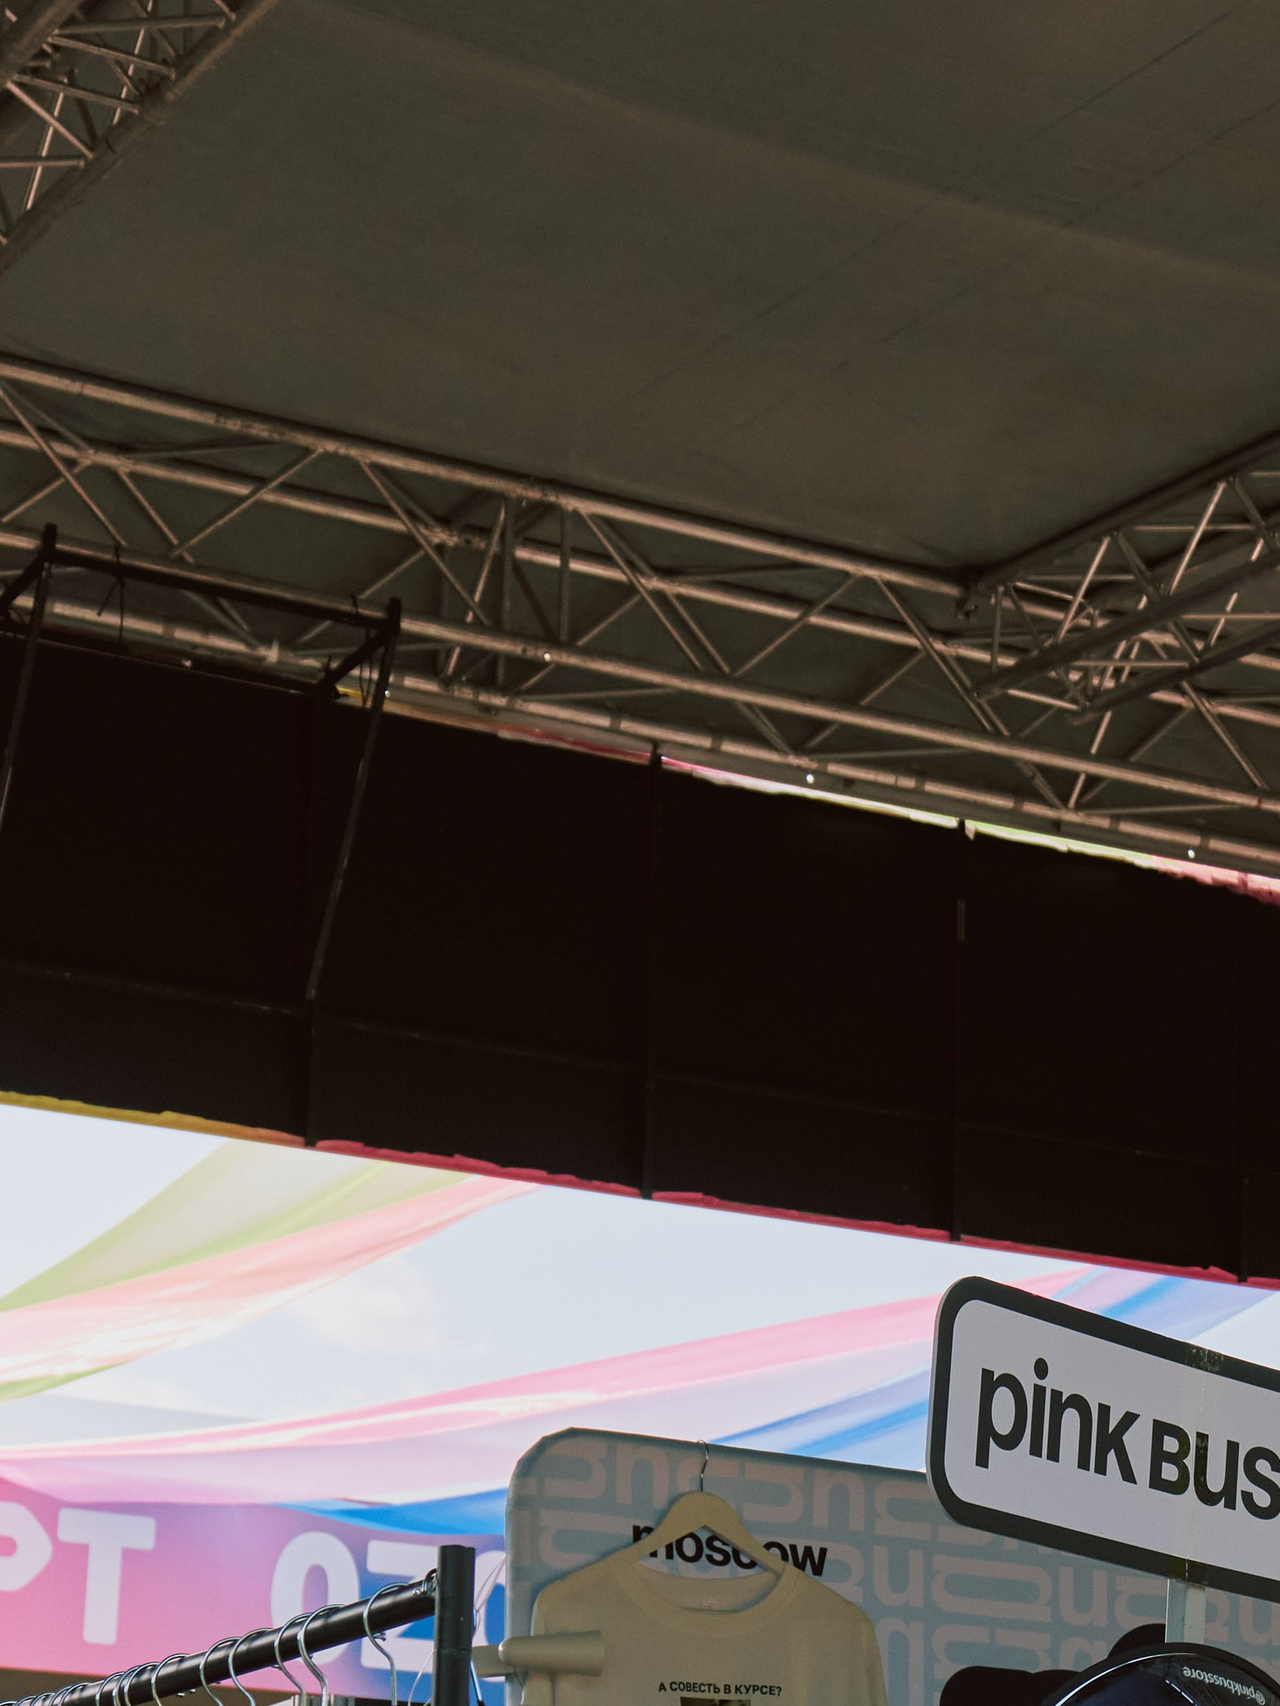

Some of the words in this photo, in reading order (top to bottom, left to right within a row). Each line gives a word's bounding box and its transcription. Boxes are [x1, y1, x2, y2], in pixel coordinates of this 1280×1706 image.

[976, 1358, 1141, 1484] pink
[658, 1681, 667, 1692] А
[669, 1681, 721, 1694] СОВЕСТЬ
[723, 1684, 732, 1694] В
[734, 1684, 782, 1696] КУРСЕ?
[1182, 1666, 1266, 1706] @pinkbusstore
